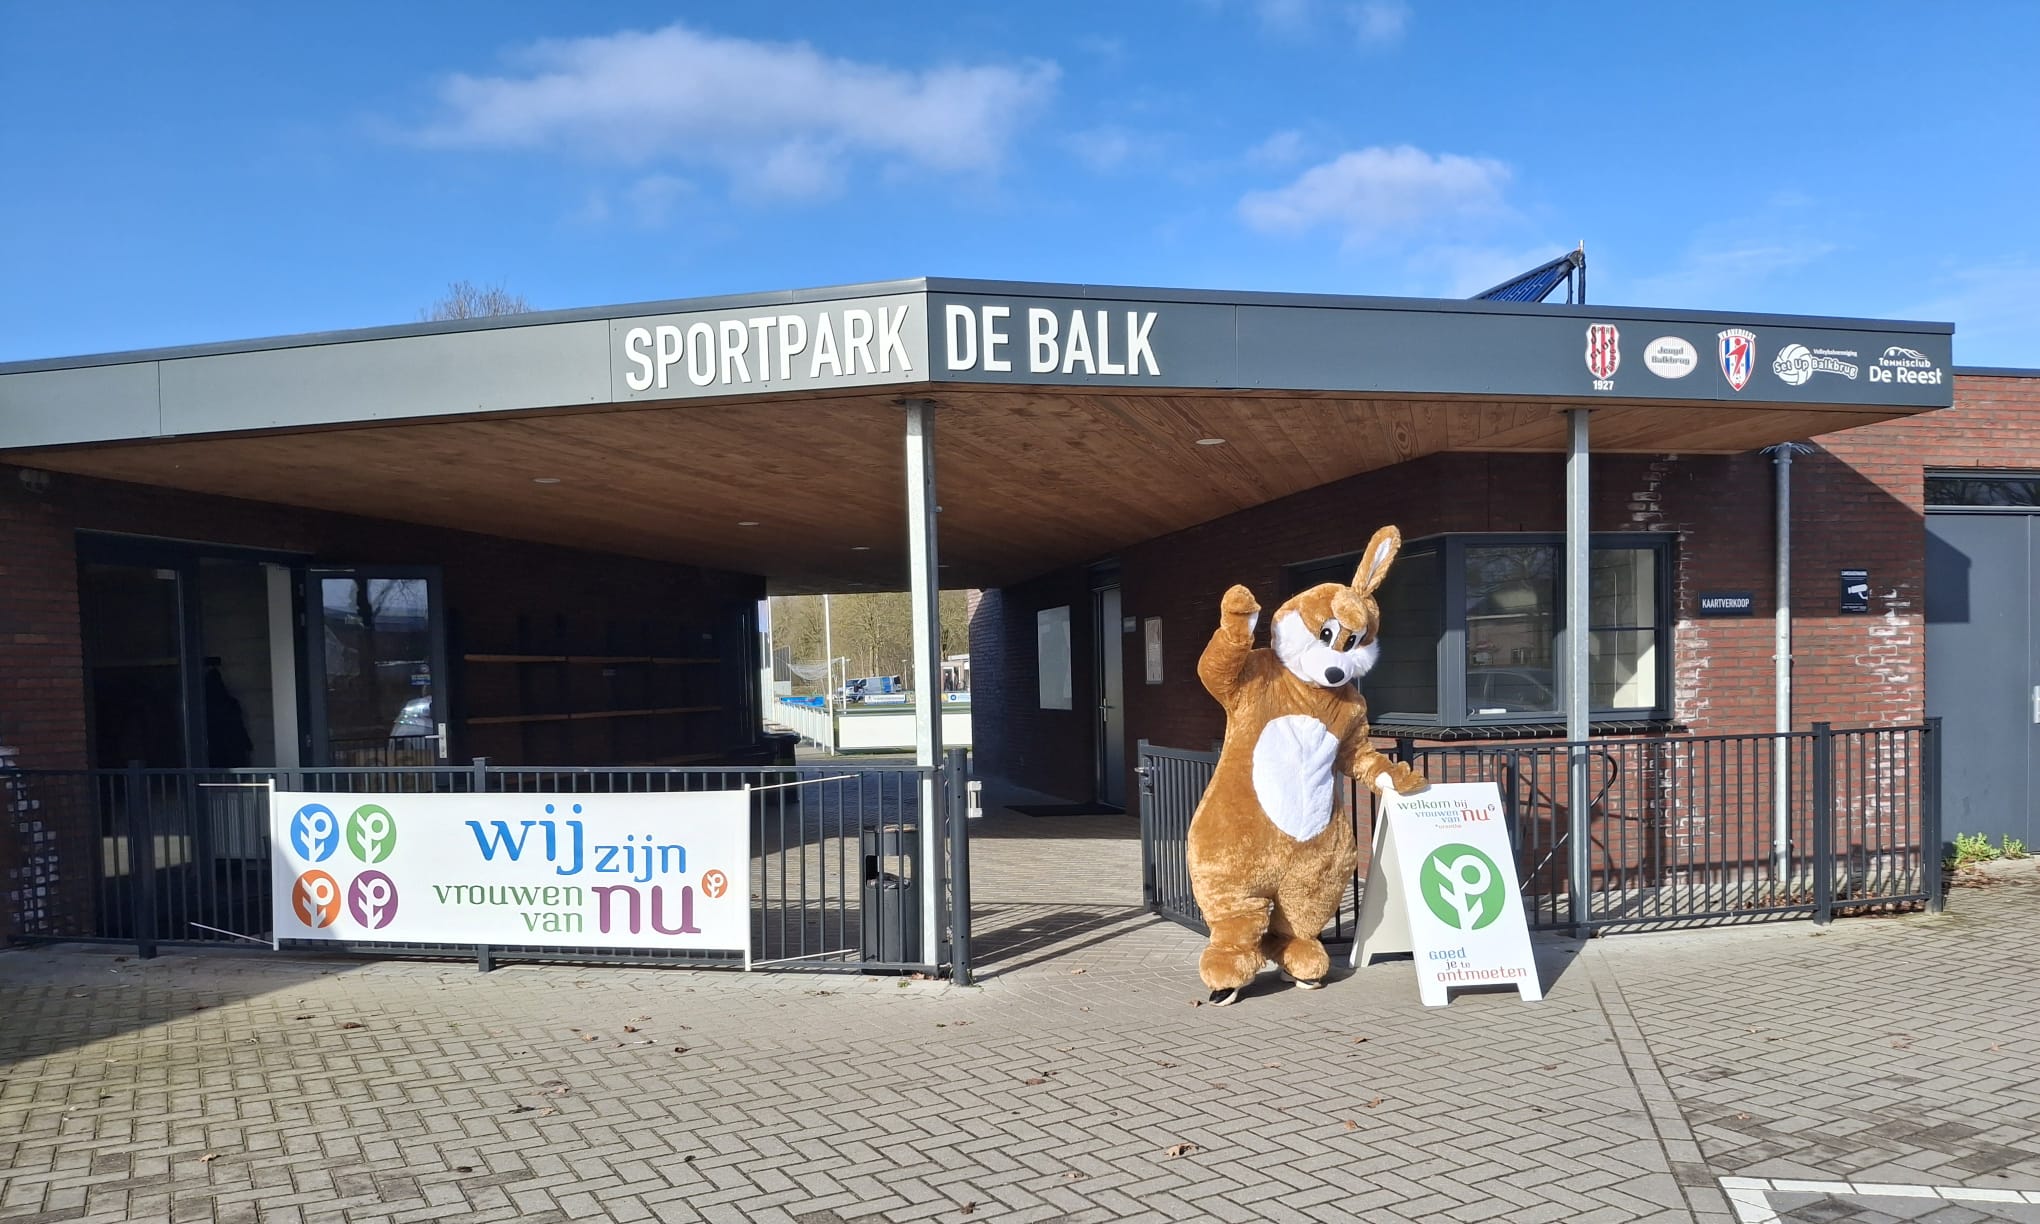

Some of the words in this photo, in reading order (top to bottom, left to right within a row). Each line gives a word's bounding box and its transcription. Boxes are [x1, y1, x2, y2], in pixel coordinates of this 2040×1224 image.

[624, 304, 913, 392] SPORTPARK
[945, 304, 1013, 372] DE
[1028, 308, 1161, 376] BALK
[1774, 361, 1792, 374] Set
[1794, 359, 1809, 371] Up
[1812, 359, 1856, 377] Balkbrug
[1878, 357, 1931, 368] Tennisclub
[1869, 366, 1892, 383] De
[1896, 366, 1943, 385] Reest
[1592, 380, 1615, 390] 1927
[1702, 598, 1750, 608] KAARTVERKOOP
[1397, 800, 1451, 811] welkom
[1454, 800, 1468, 809] bij
[1415, 810, 1459, 818] vrouwen
[1461, 809, 1491, 822] nu
[465, 803, 583, 875] wij
[594, 834, 687, 883] zijn
[432, 884, 582, 906] vrouwen
[520, 911, 583, 933] van
[591, 885, 702, 935] nu
[1445, 959, 1458, 970] je
[1436, 966, 1528, 982] ontmoeten
